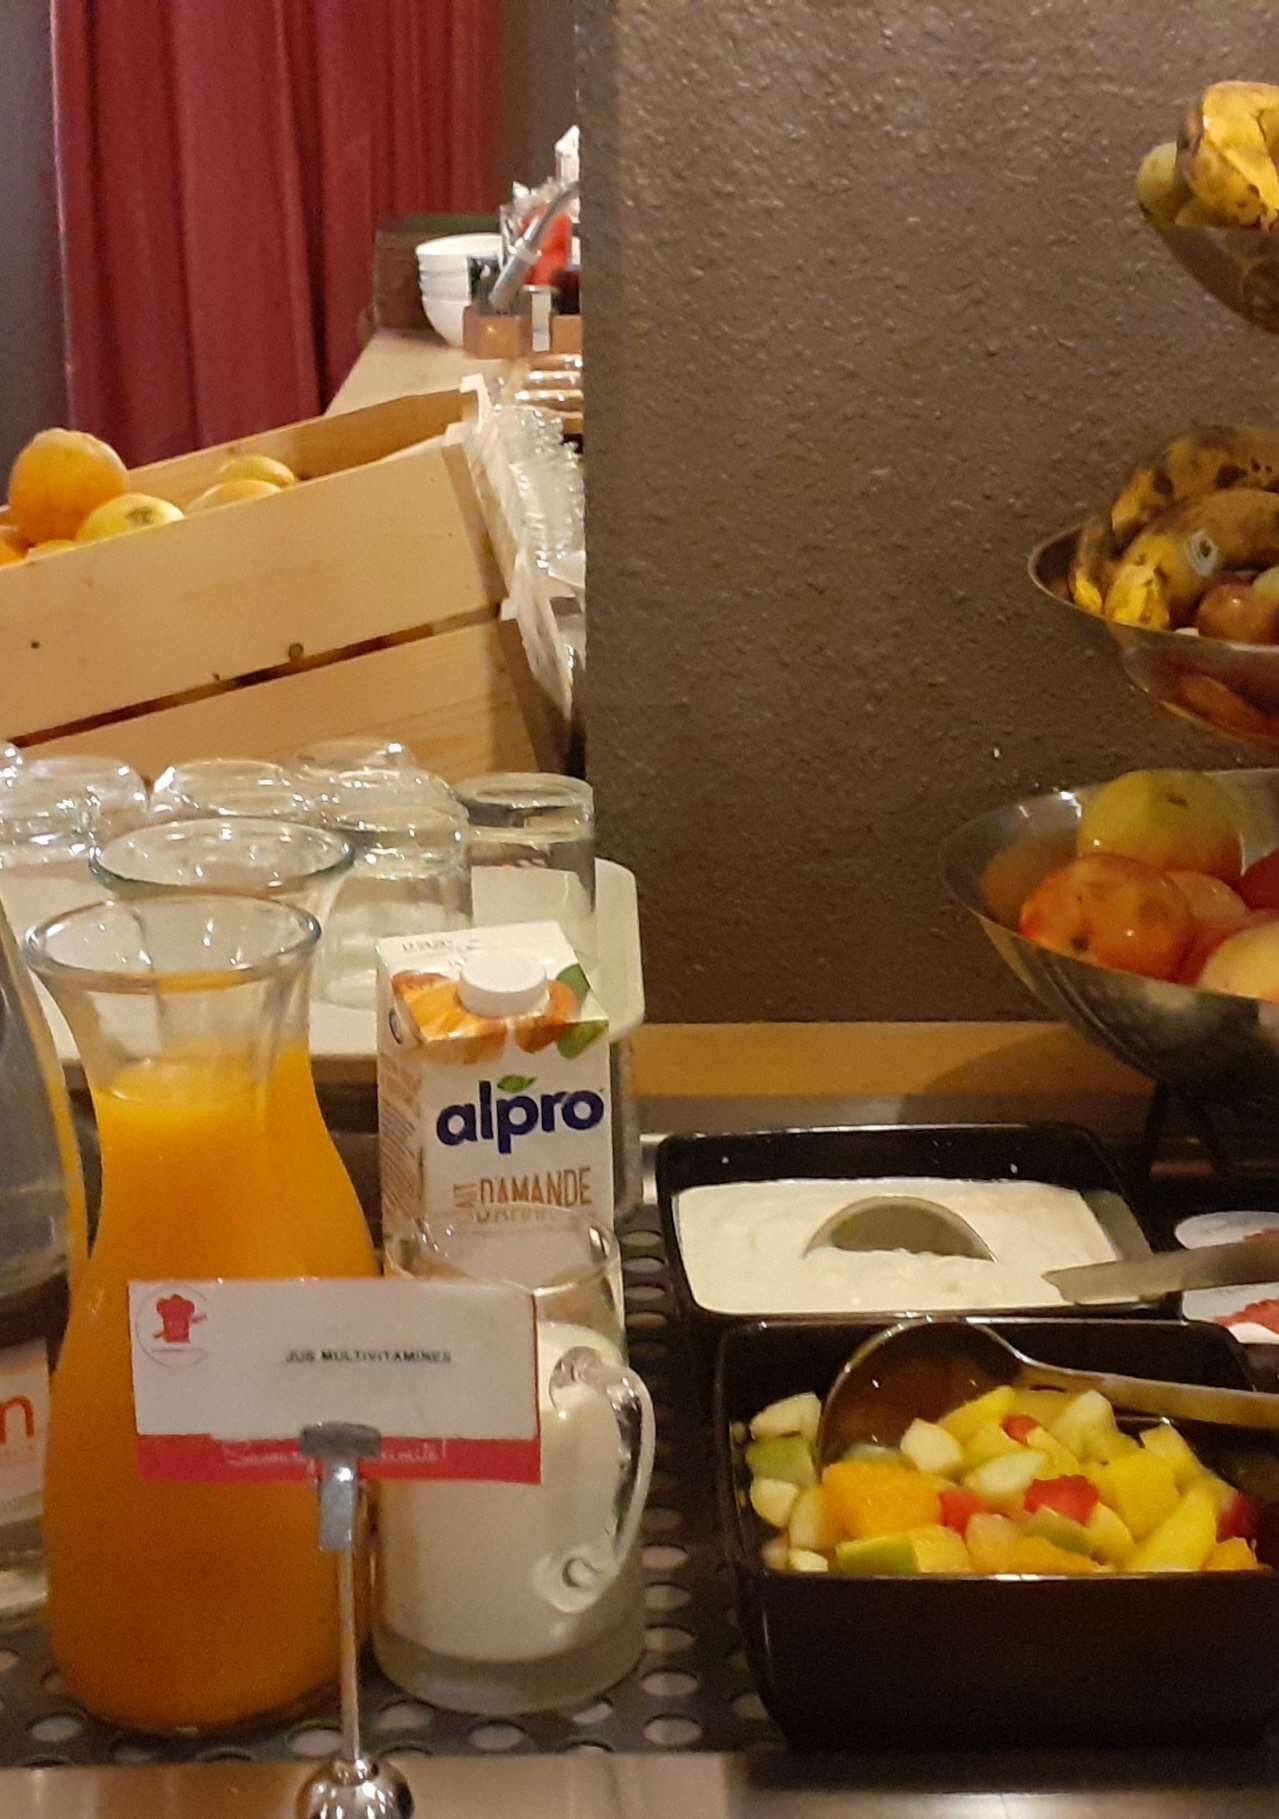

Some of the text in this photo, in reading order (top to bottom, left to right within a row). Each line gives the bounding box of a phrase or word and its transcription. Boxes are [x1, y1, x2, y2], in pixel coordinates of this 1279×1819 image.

[435, 1080, 605, 1154] alpro
[479, 1166, 593, 1207] D'AMANDE
[286, 1349, 452, 1364] JUS MULTIVITAMINES
